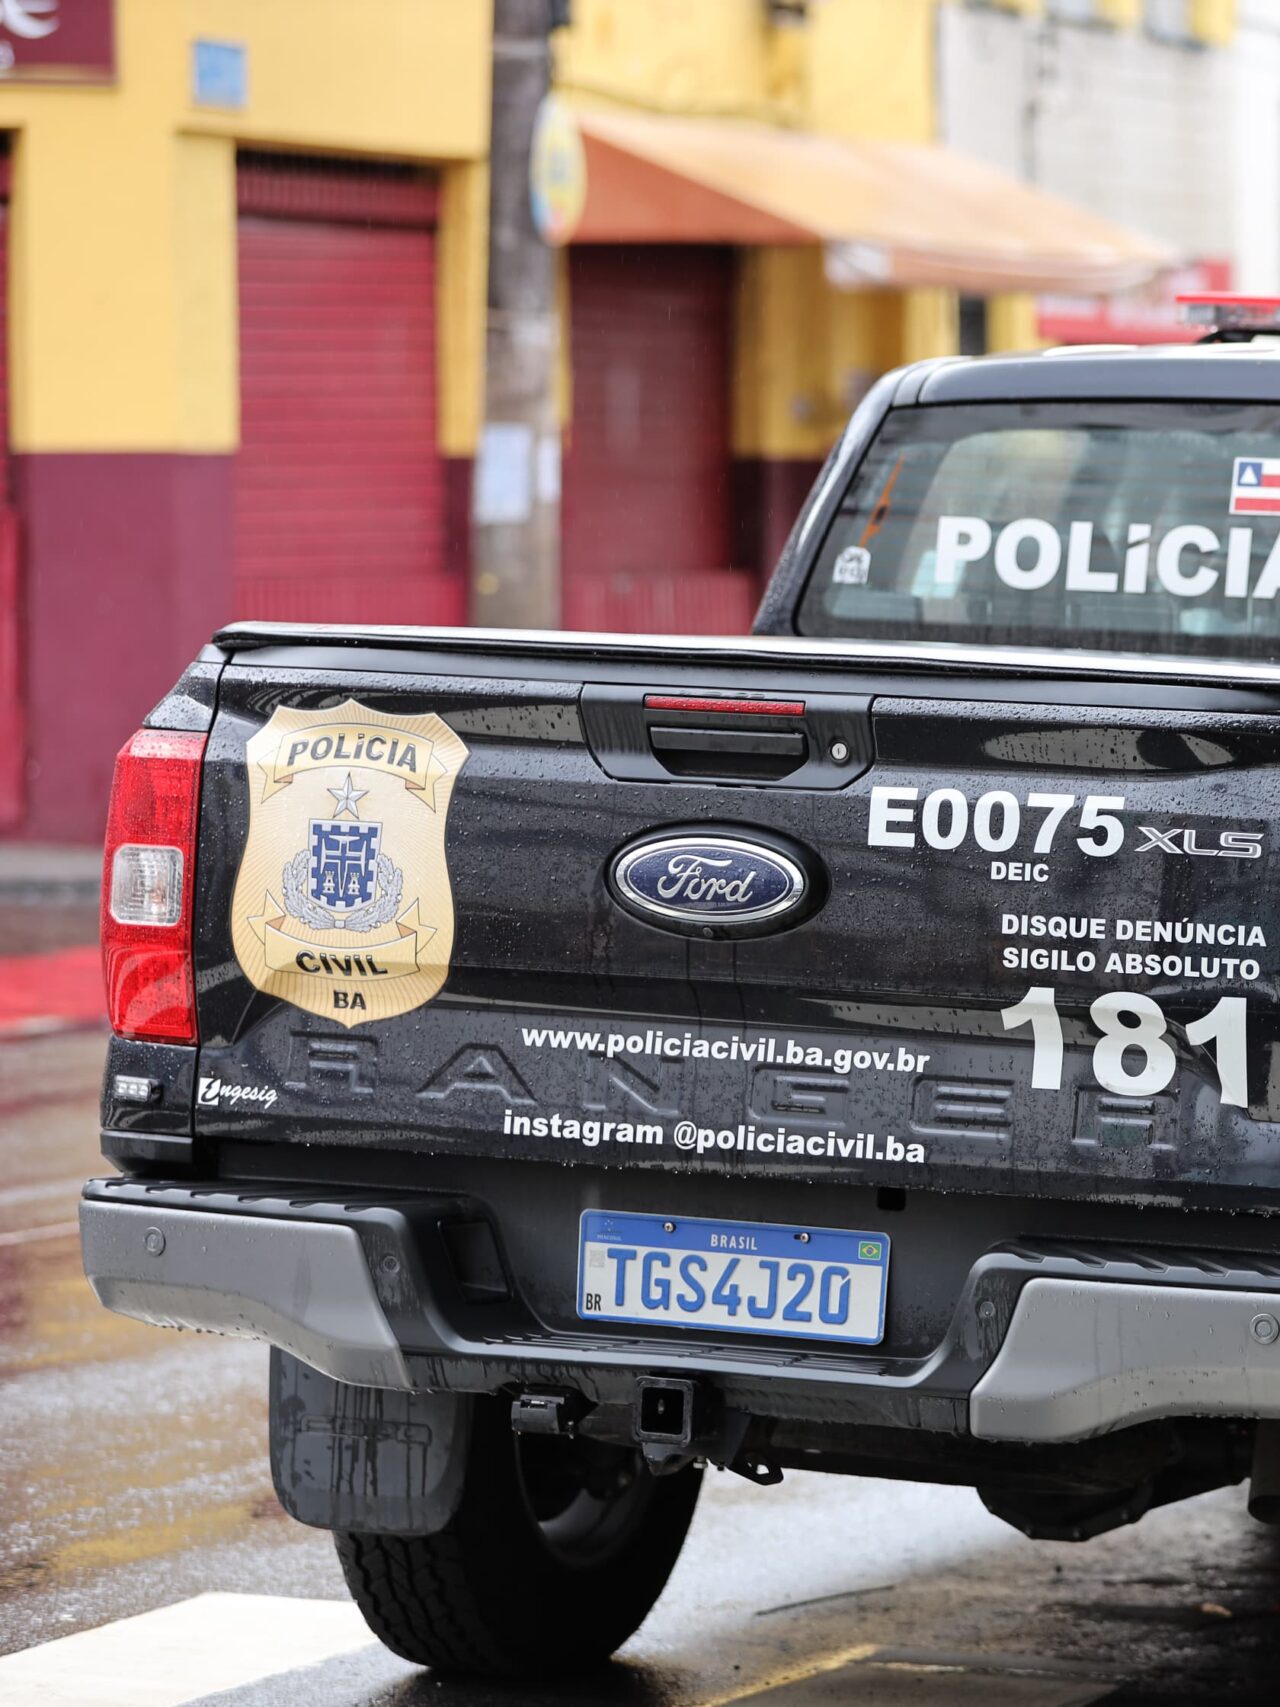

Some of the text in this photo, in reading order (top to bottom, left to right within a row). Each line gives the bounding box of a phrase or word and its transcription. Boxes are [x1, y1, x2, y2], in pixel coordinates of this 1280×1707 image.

[287, 732, 416, 773] POLÍCIA
[867, 786, 1126, 857] E0075
[1134, 826, 1264, 859] XLS
[657, 854, 756, 902] Ford
[991, 861, 1049, 883] DEIC
[1002, 914, 1267, 947] DISQUE DENÚNCIA
[296, 950, 388, 976] CIVIL
[1002, 947, 1260, 980] SIGILO ABSOLUTO
[333, 990, 366, 1010] BA
[521, 1027, 930, 1074] www.policiacivil.ba.gov.br
[1001, 986, 1248, 1108] 181
[284, 1030, 1178, 1151] RANGER
[504, 1110, 925, 1163] instagram @policiacivil.ba
[710, 1233, 758, 1251] BRASIL
[585, 1293, 602, 1312] BR
[607, 1247, 851, 1325] TGS4J20
